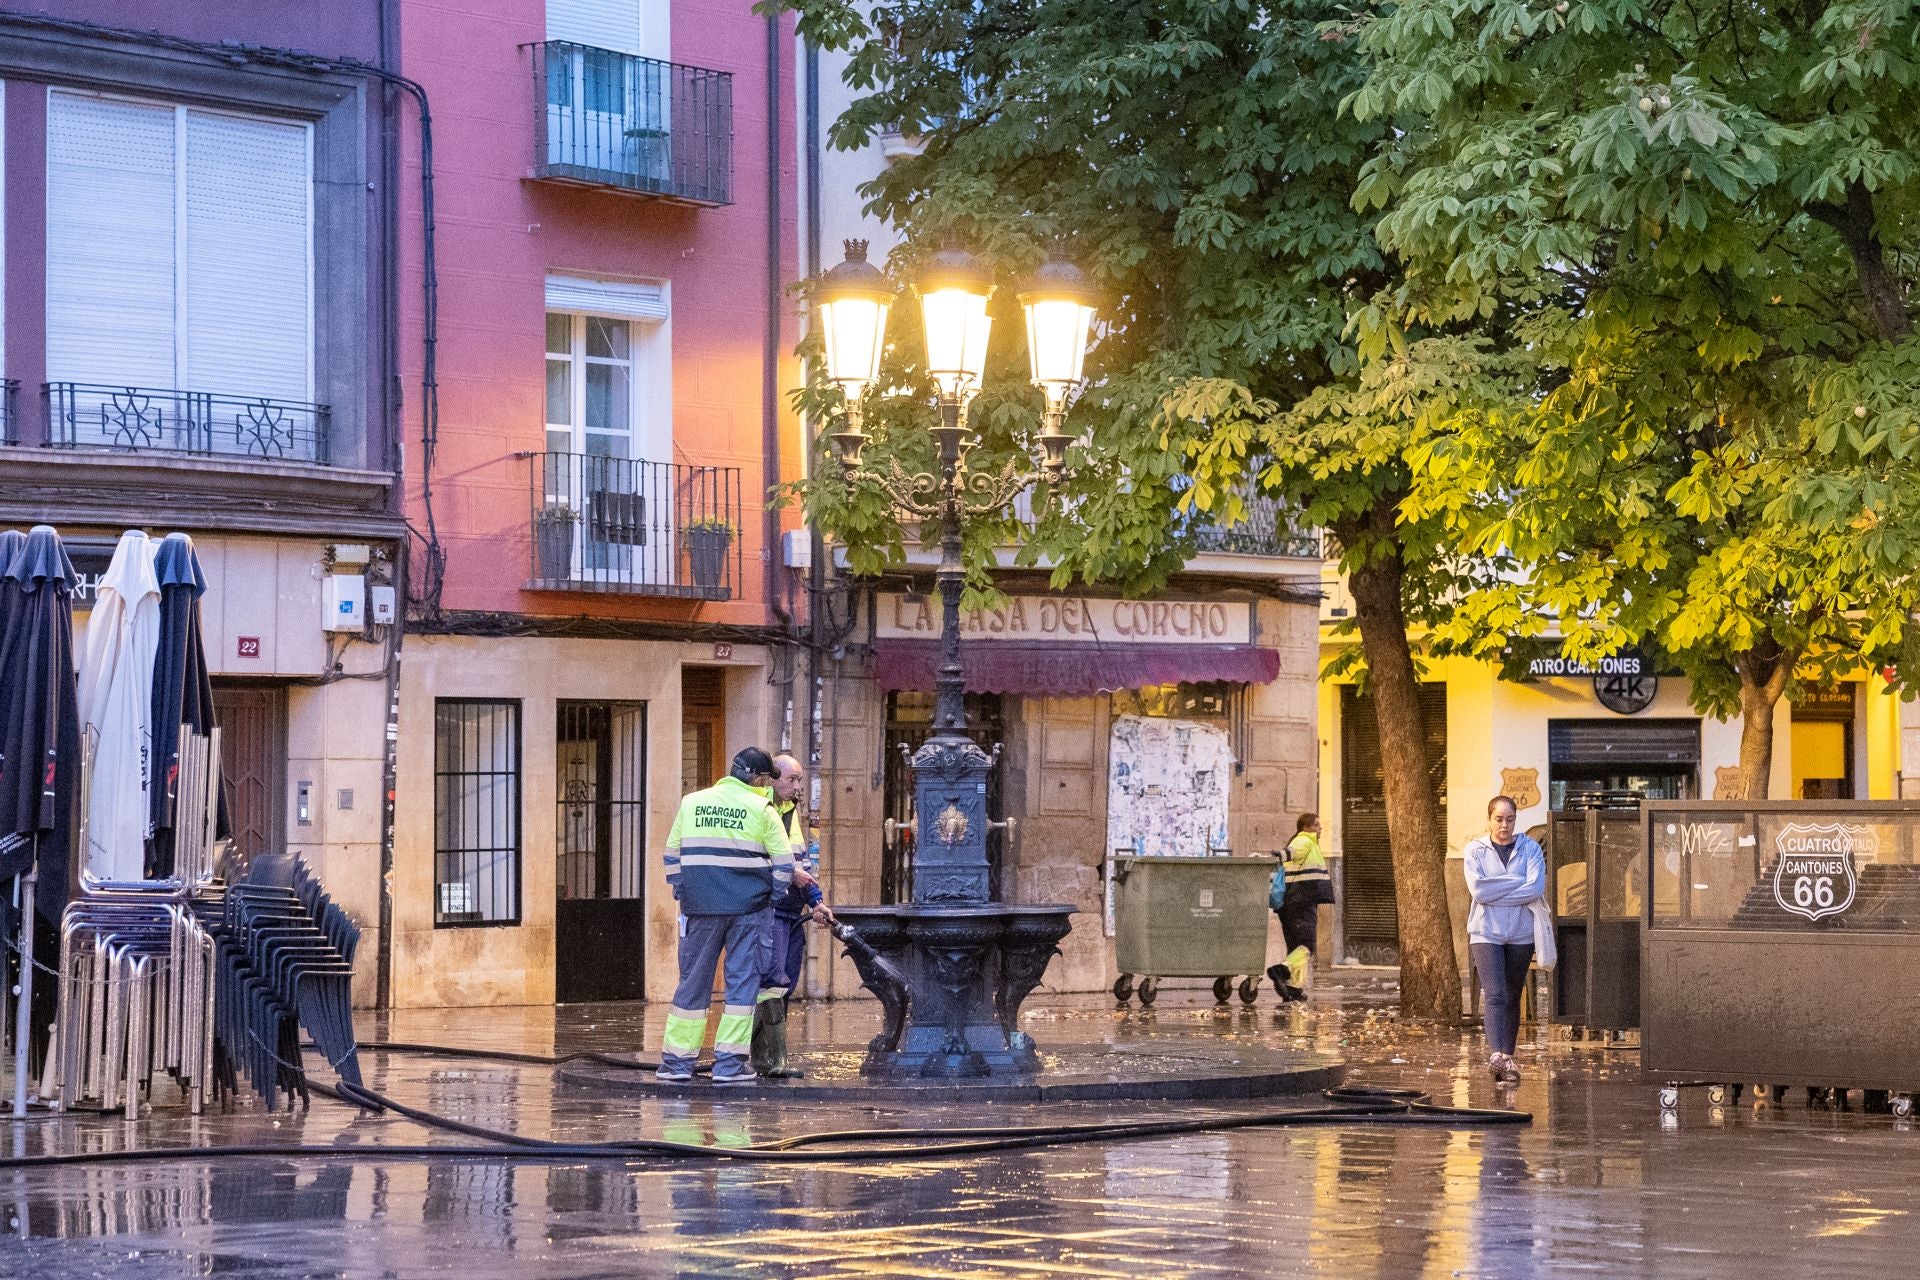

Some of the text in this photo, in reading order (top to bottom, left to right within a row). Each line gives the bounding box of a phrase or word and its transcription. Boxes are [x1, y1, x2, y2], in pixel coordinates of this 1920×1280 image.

[894, 595, 1227, 639] LA ASA DEL CORCHO
[240, 641, 257, 653] 22
[717, 645, 730, 657] 23
[1603, 676, 1645, 697] 4K
[695, 805, 747, 819] ENCARGADO
[695, 816, 744, 831] LIMPIEZA
[1787, 838, 1843, 852] CUATRO
[1786, 861, 1843, 875] CANTONES
[1794, 876, 1834, 907] 66
